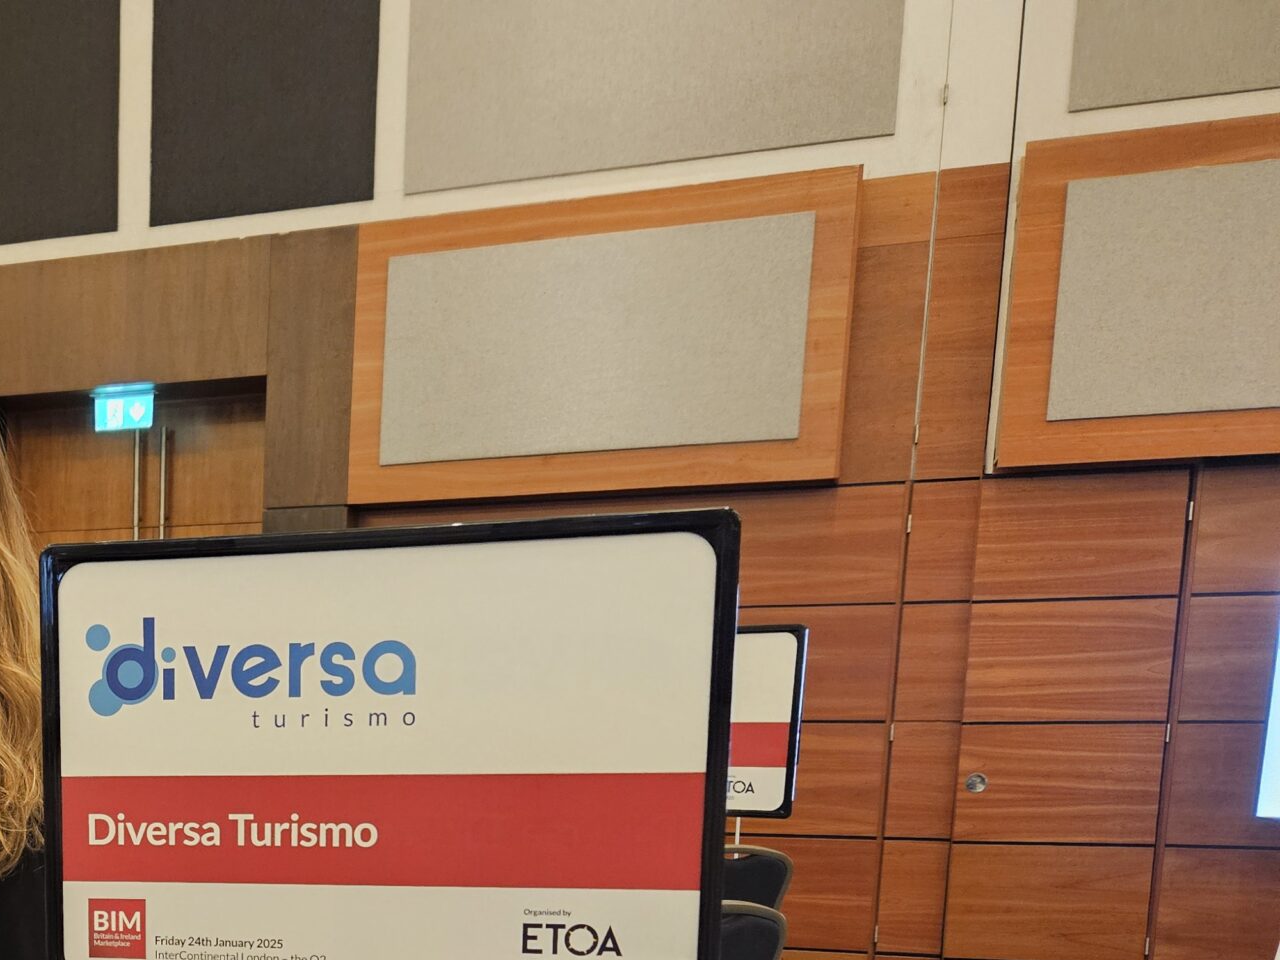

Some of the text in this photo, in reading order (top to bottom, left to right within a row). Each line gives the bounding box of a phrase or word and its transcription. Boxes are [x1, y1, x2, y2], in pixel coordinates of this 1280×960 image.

[106, 617, 417, 700] diversa
[252, 708, 416, 728] turismo
[726, 780, 755, 794] TOA
[88, 812, 378, 848] Diversa Turismo
[93, 910, 141, 932] BIM
[523, 908, 572, 917] Organised by
[93, 932, 113, 940] Britain
[120, 933, 141, 941] Ireland
[93, 940, 131, 948] Marketplace
[155, 935, 284, 950] Friday 24th January 2025
[522, 923, 623, 956] ETOA
